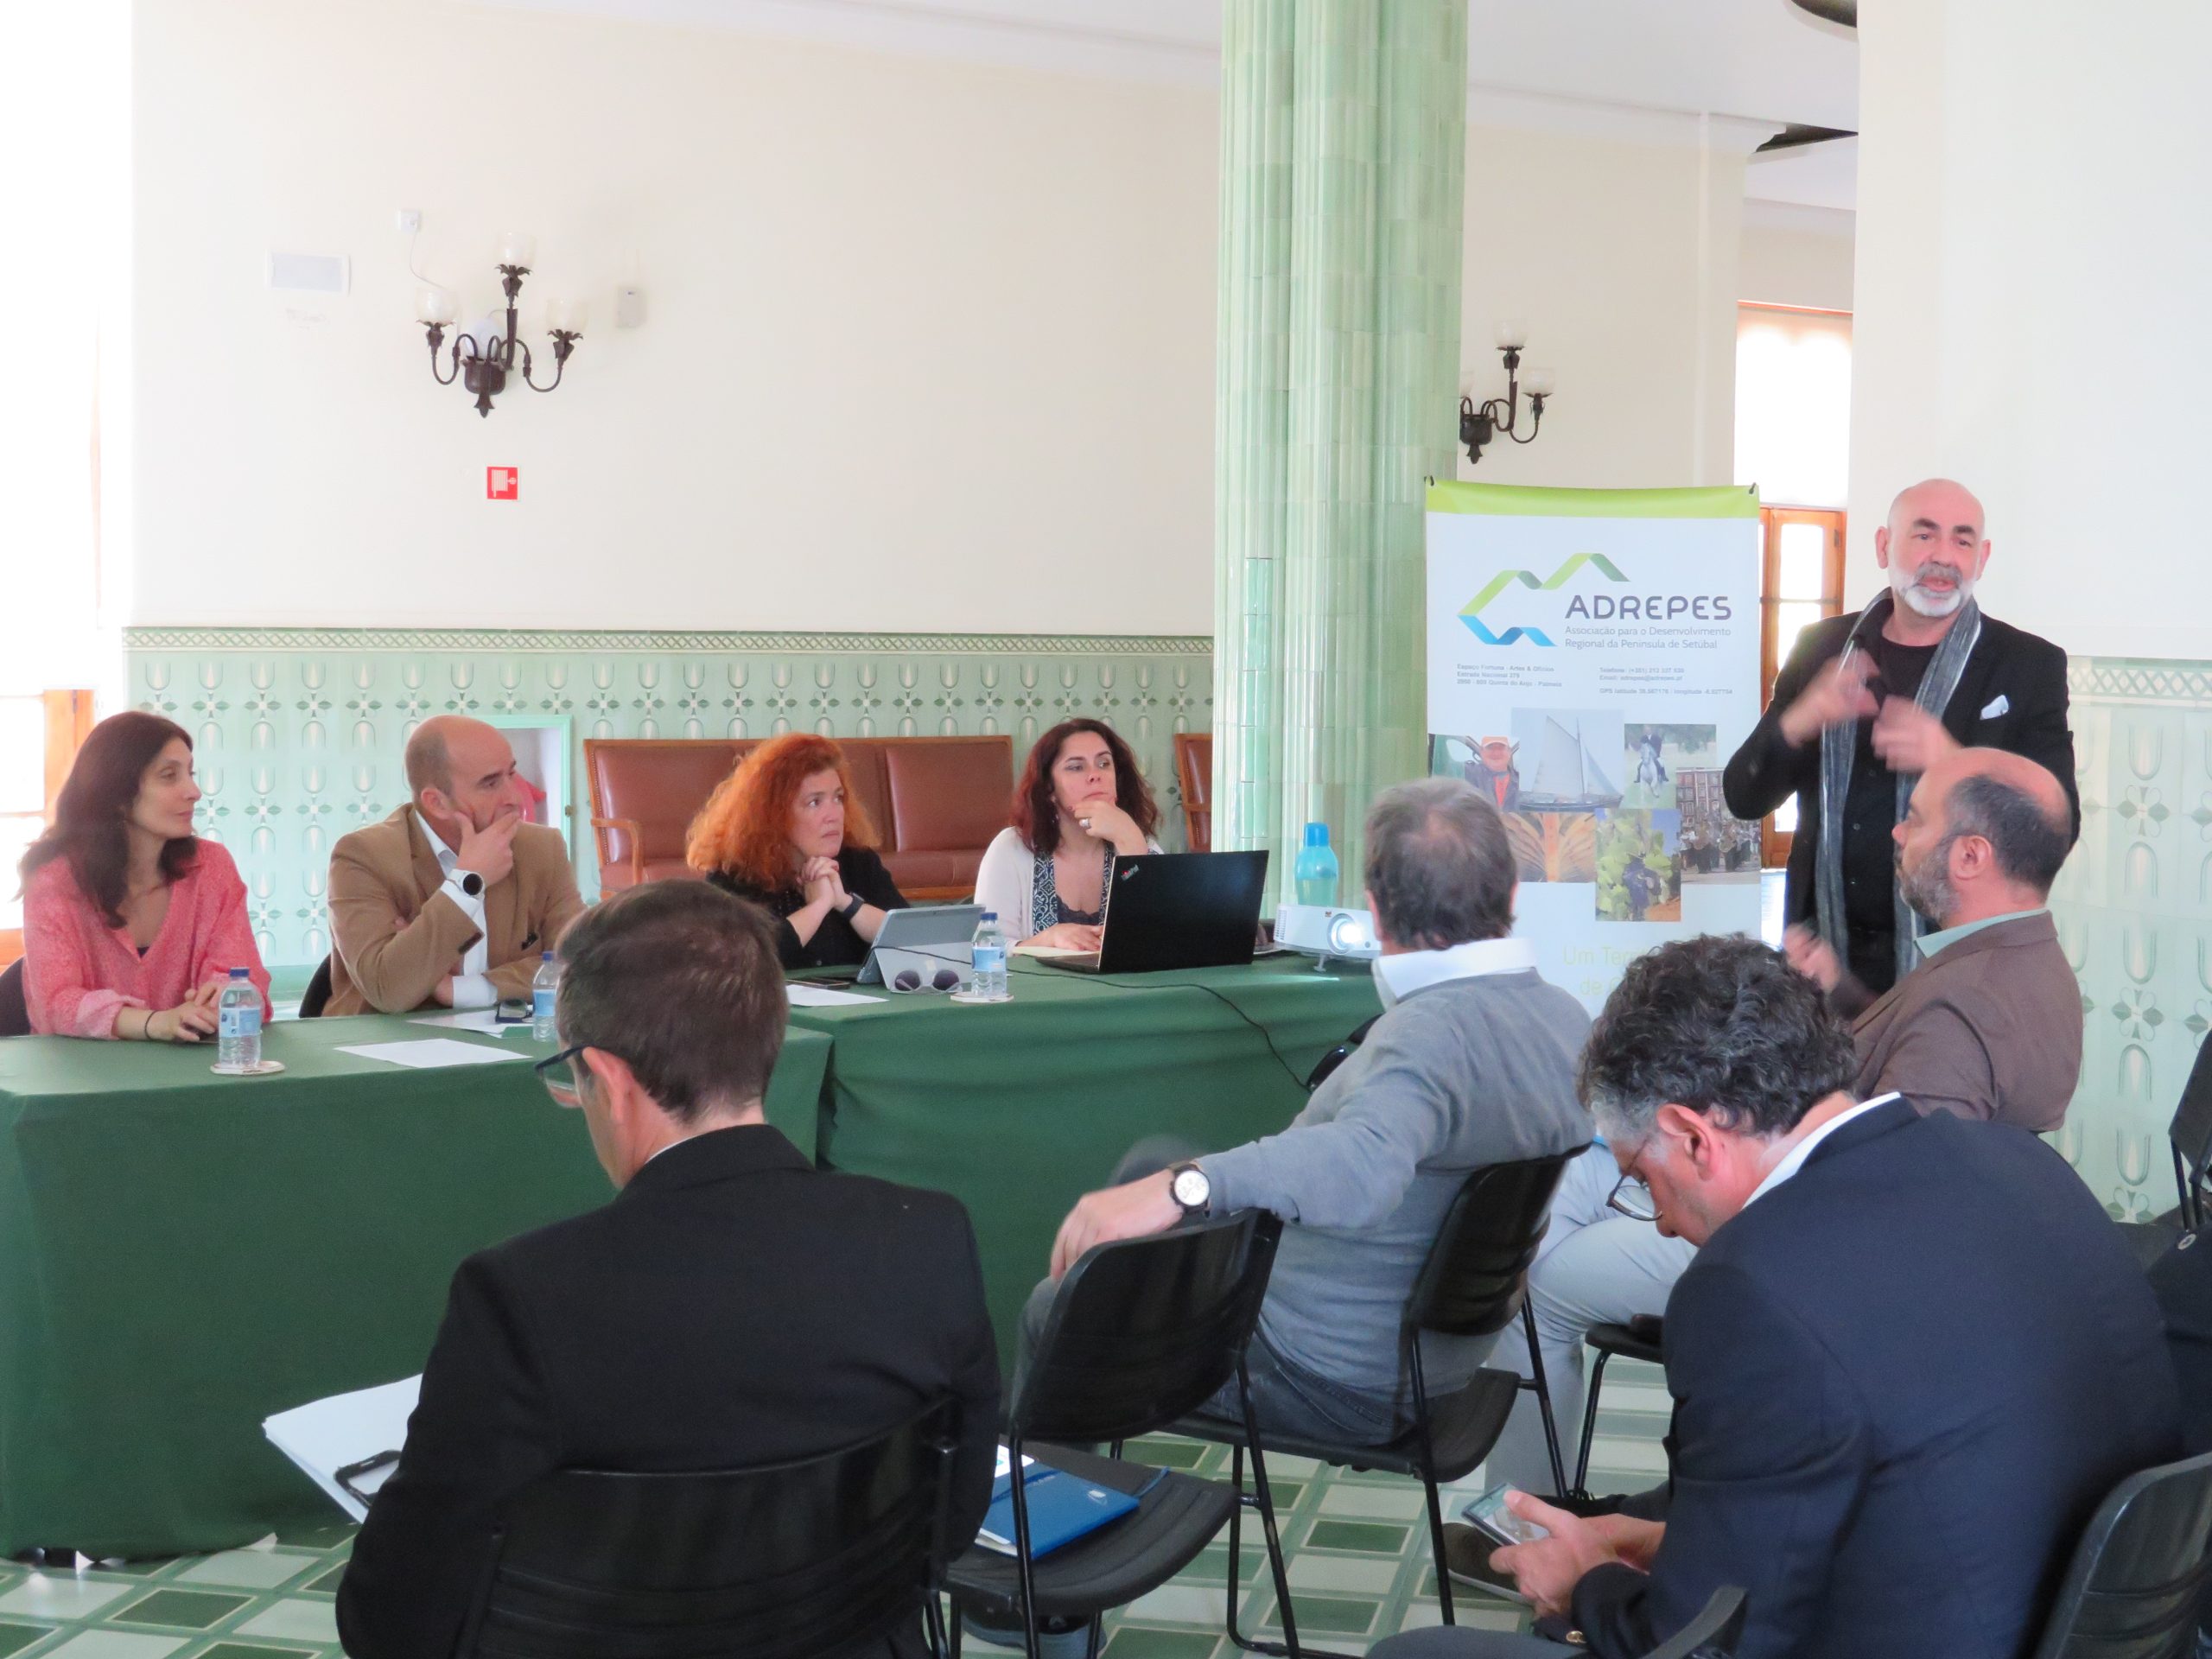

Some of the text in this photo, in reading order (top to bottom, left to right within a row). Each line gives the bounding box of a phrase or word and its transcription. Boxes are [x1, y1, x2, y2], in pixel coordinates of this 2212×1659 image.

[1565, 594, 1732, 620] ADREPES
[1565, 626, 1616, 636] Associação
[1618, 628, 1638, 637] para
[1649, 626, 1731, 635] Desenvolvimento
[1565, 638, 1605, 650] Regional
[1607, 639, 1618, 648] da
[1668, 639, 1680, 648] de
